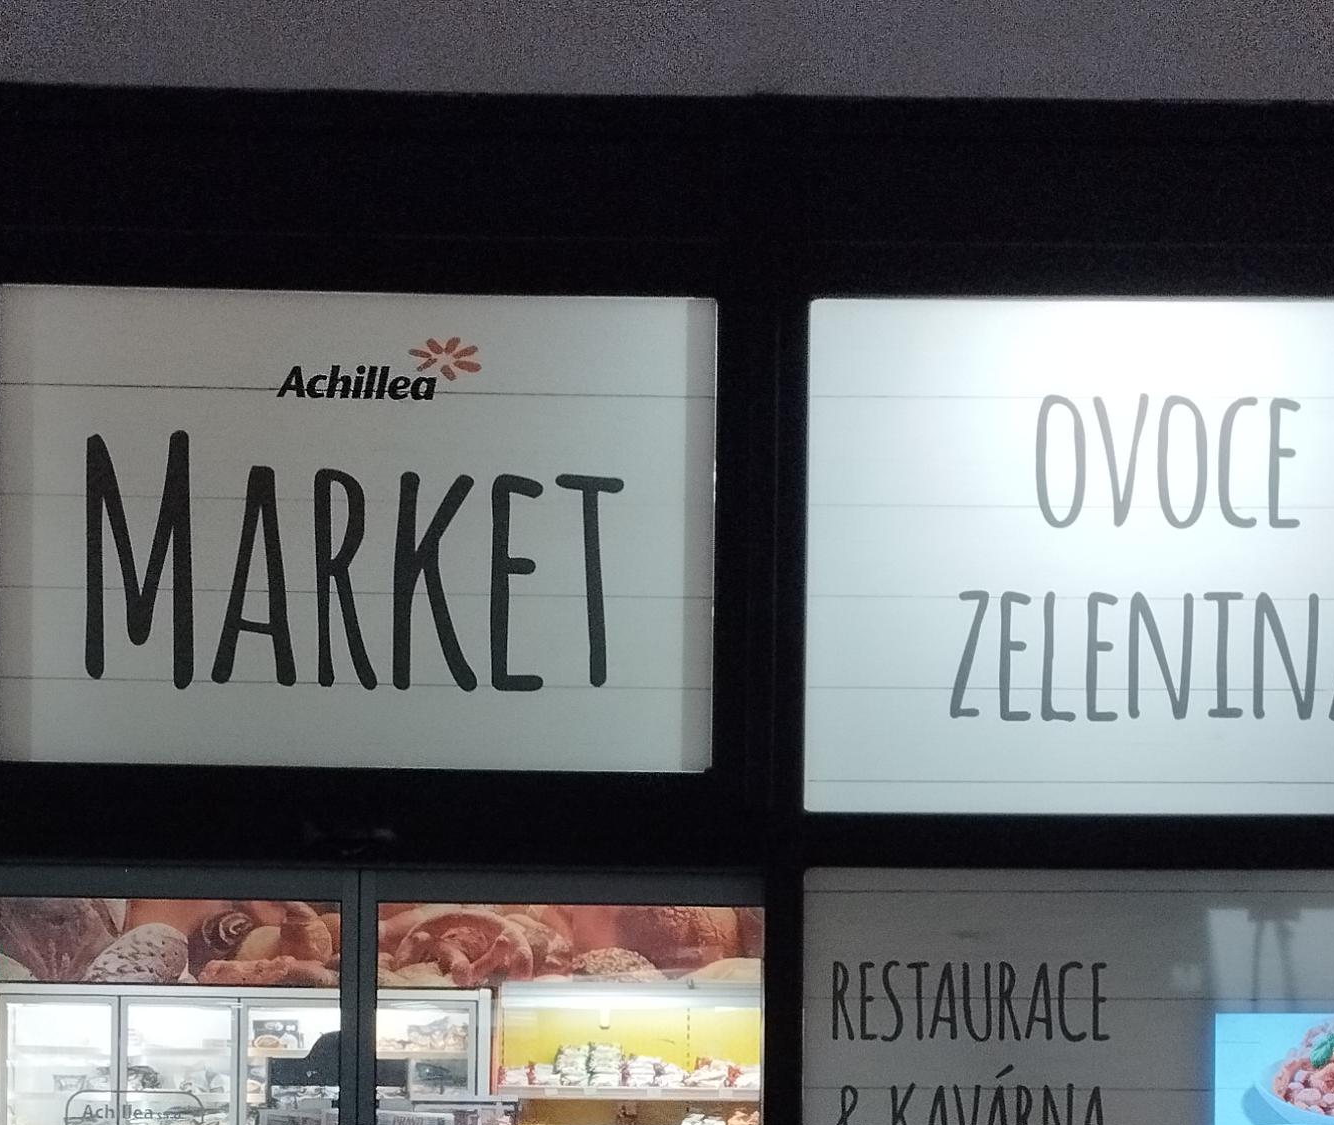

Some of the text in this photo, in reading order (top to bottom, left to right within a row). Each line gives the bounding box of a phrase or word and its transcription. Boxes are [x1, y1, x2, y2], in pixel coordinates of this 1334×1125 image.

[276, 365, 437, 400] Achillea
[1035, 392, 1301, 529] OVOCE
[85, 430, 624, 692] MARKET
[832, 960, 1110, 1042] RESTAURACE
[82, 1104, 153, 1120] Achllea
